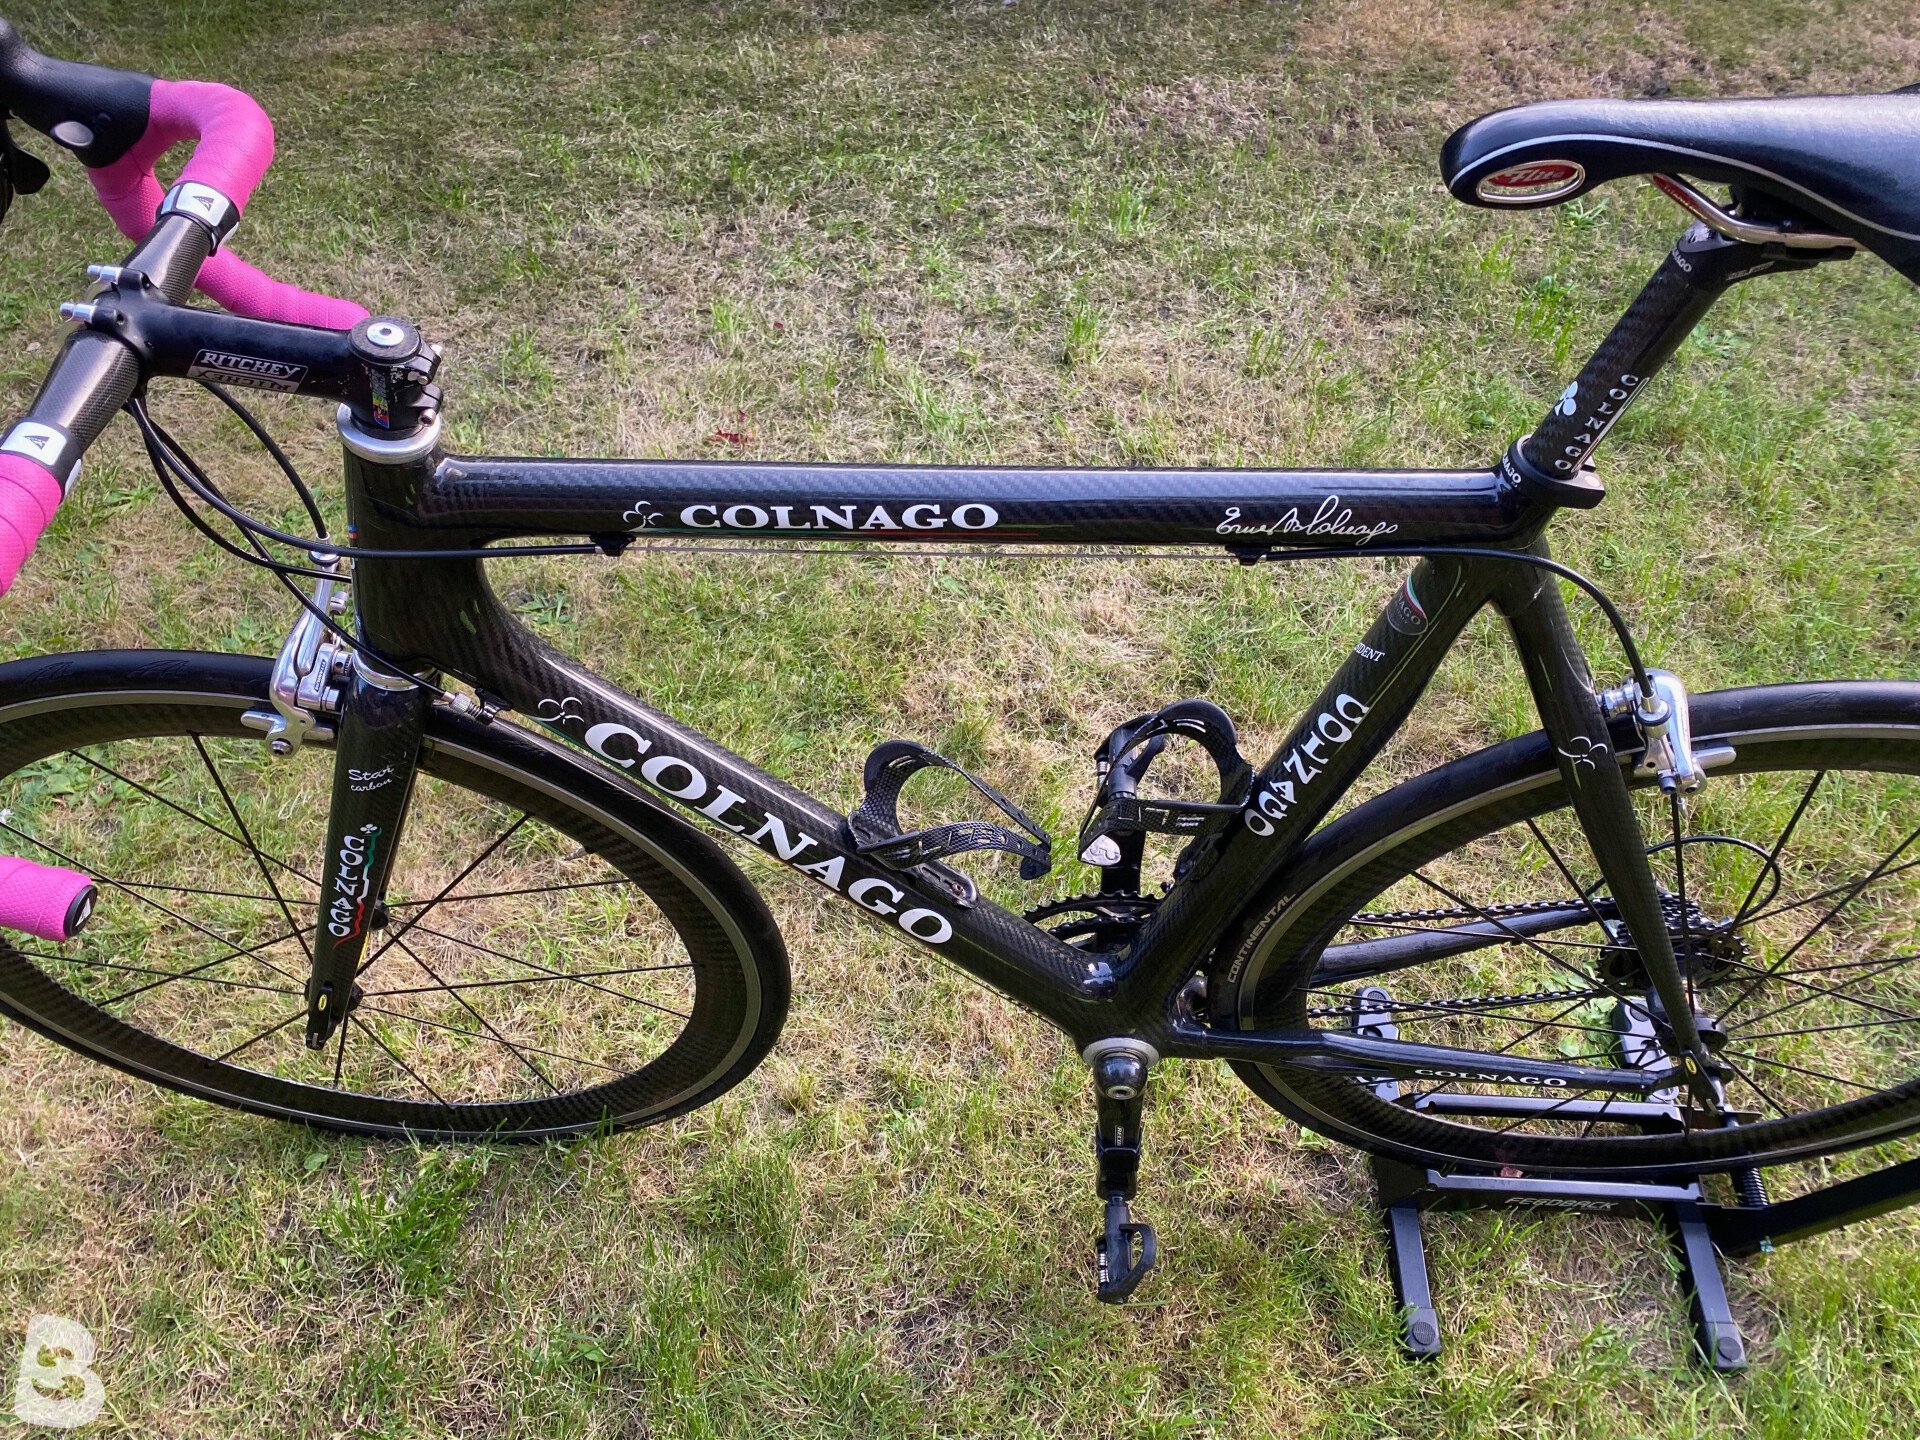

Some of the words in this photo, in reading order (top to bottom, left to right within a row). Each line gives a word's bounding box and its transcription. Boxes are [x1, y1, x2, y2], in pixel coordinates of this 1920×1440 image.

[200, 352, 301, 377] RITCHEY
[1555, 374, 1639, 471] COLNAGO
[680, 503, 999, 530] COLNAGO
[350, 777, 393, 792] carbon
[1244, 693, 1370, 837] COLNAGO
[584, 722, 953, 944] COLNAGO
[329, 835, 365, 937] COLNAGO
[1228, 893, 1297, 984] CONTINENTAL
[1414, 1069, 1567, 1087] COLNAGO
